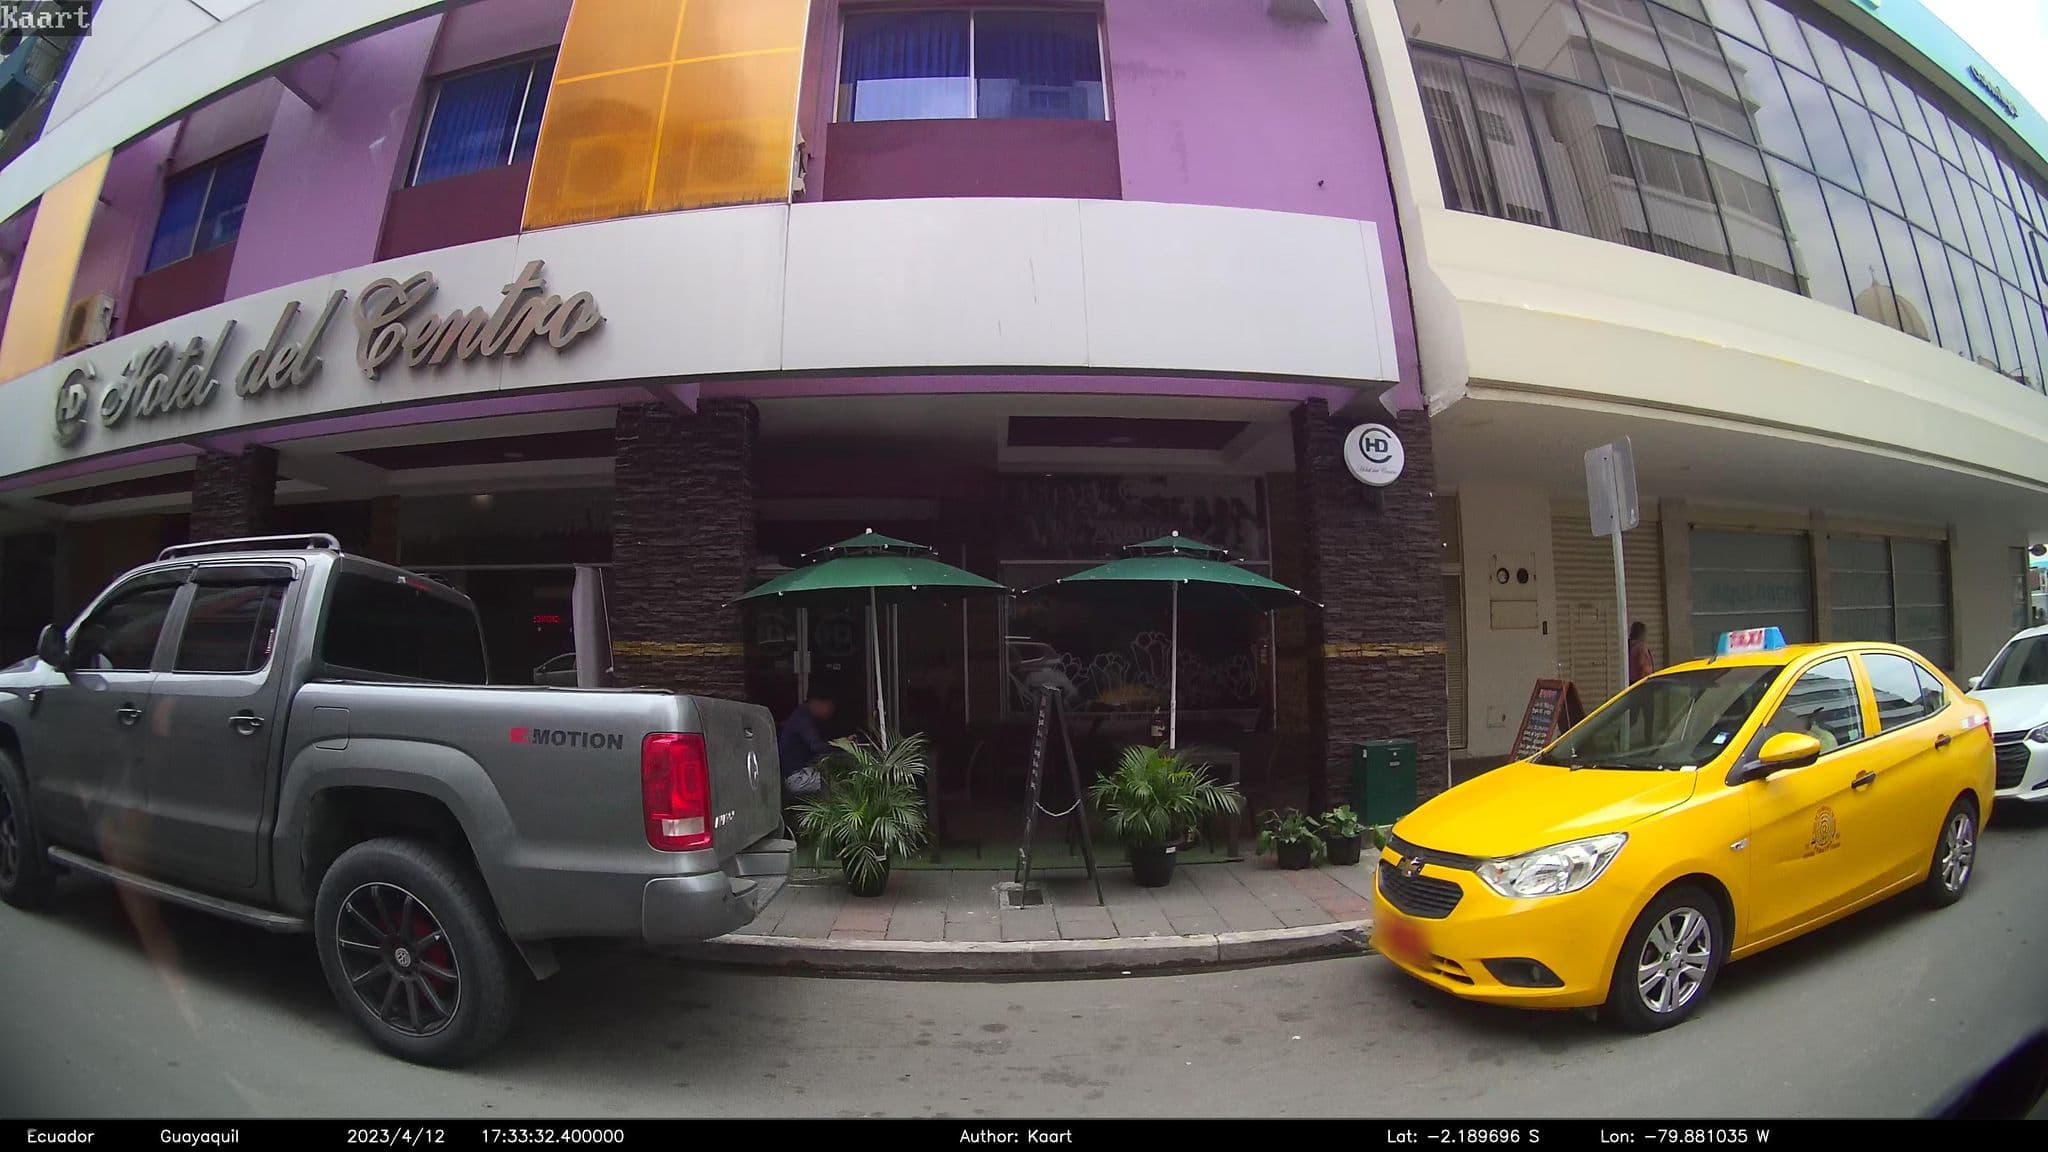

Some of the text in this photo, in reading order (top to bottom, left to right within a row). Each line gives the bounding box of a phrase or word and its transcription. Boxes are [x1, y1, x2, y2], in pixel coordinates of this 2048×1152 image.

[101, 259, 607, 428] Hotel del Centro
